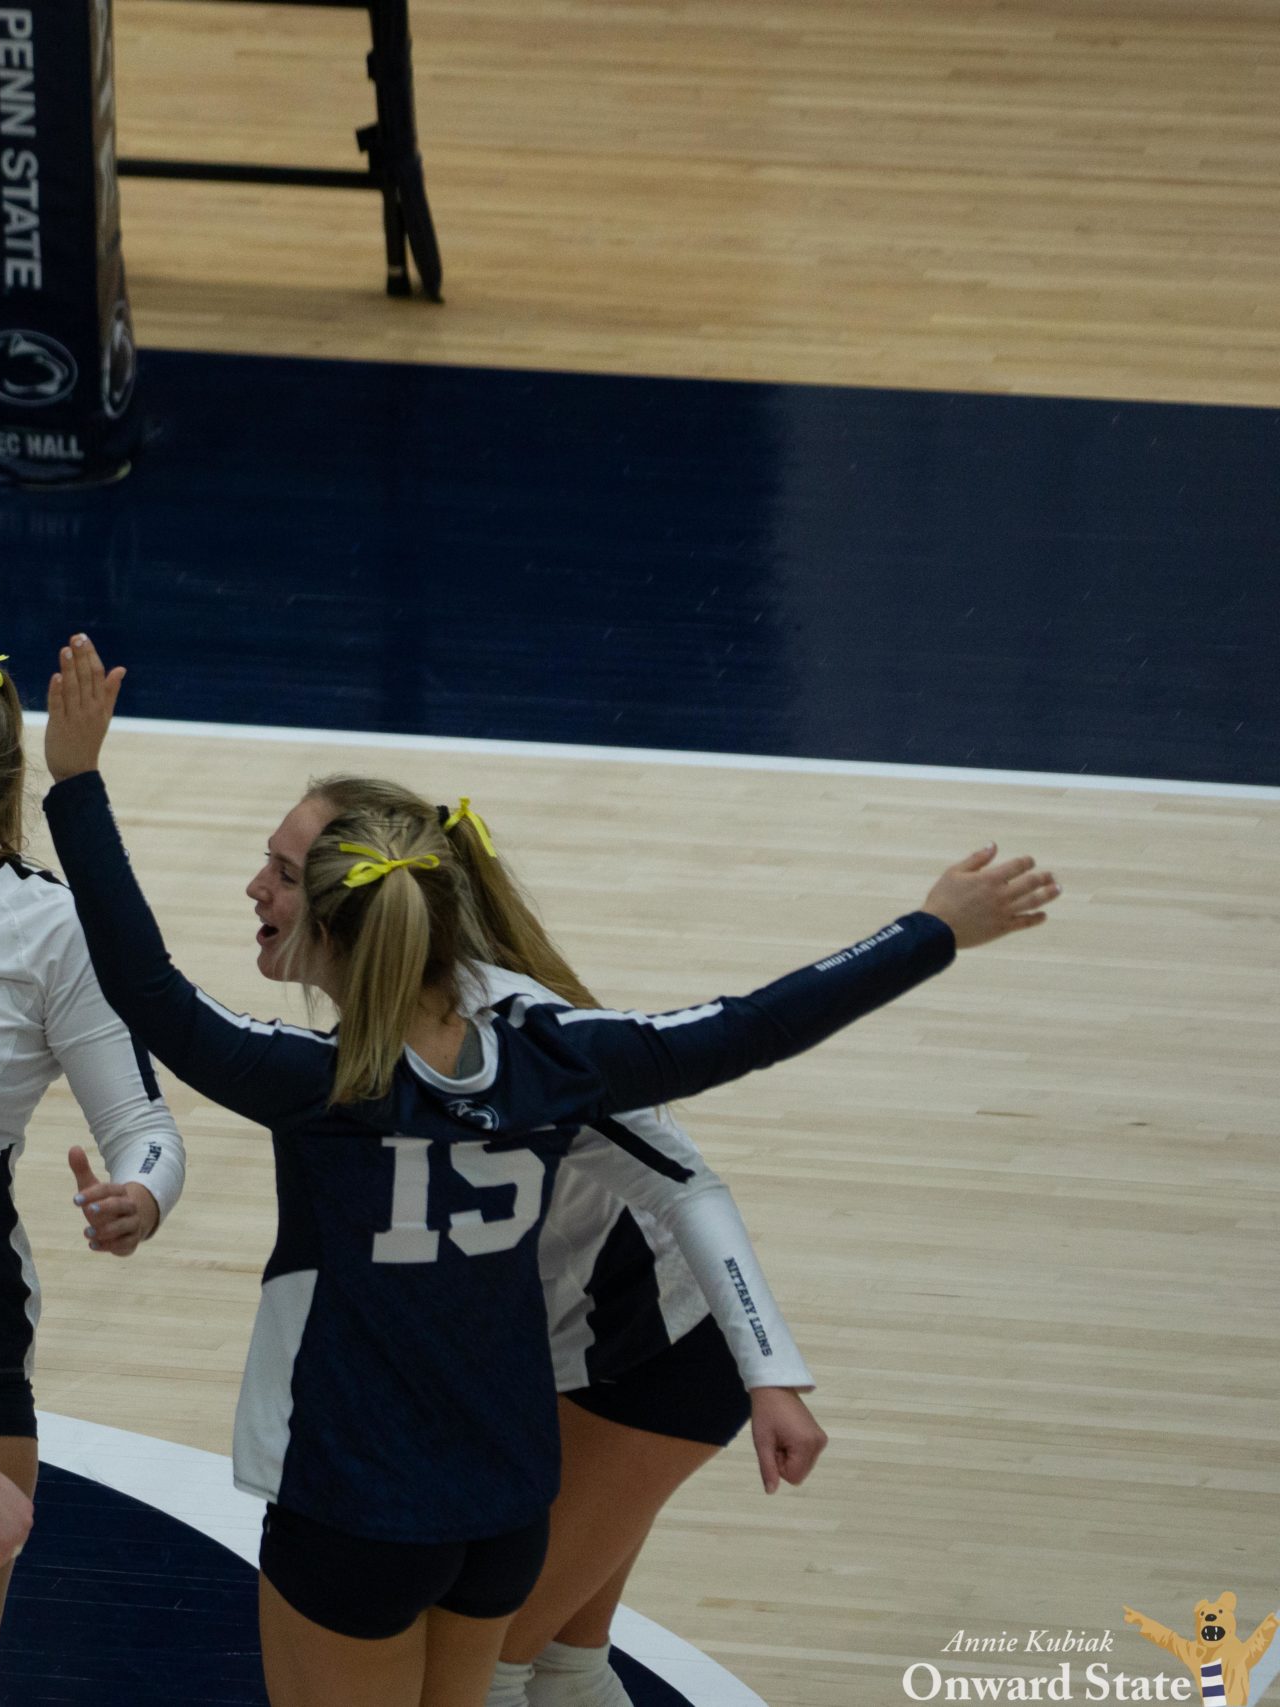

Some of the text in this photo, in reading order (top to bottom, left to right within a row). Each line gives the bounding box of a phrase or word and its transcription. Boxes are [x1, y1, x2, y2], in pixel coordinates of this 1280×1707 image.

[0, 150, 43, 291] STATE
[25, 433, 85, 459] HALL
[371, 1136, 546, 1264] 15
[724, 1257, 773, 1357] NITTANY LIONS
